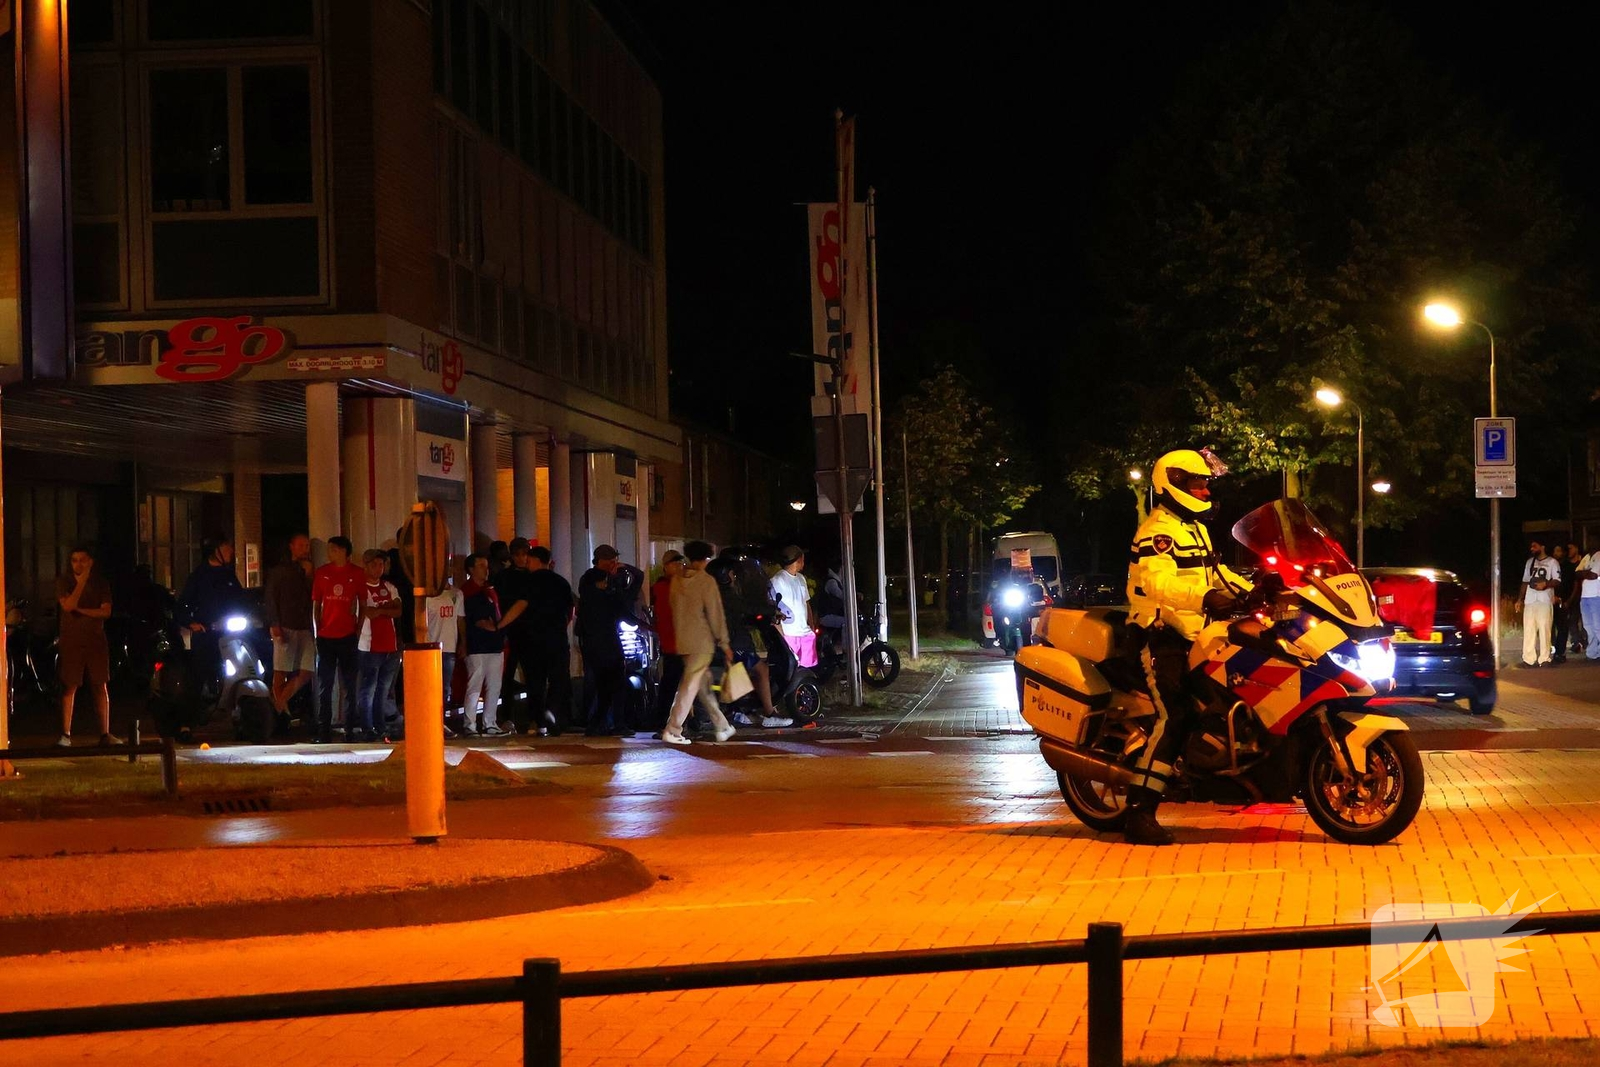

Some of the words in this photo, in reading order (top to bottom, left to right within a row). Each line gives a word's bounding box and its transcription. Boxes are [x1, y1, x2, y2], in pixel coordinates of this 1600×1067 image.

[420, 331, 463, 395] tango
[1488, 431, 1501, 448] P
[429, 440, 455, 474] tango
[1336, 580, 1362, 591] POLITIE
[1031, 695, 1072, 721] POLITIE
